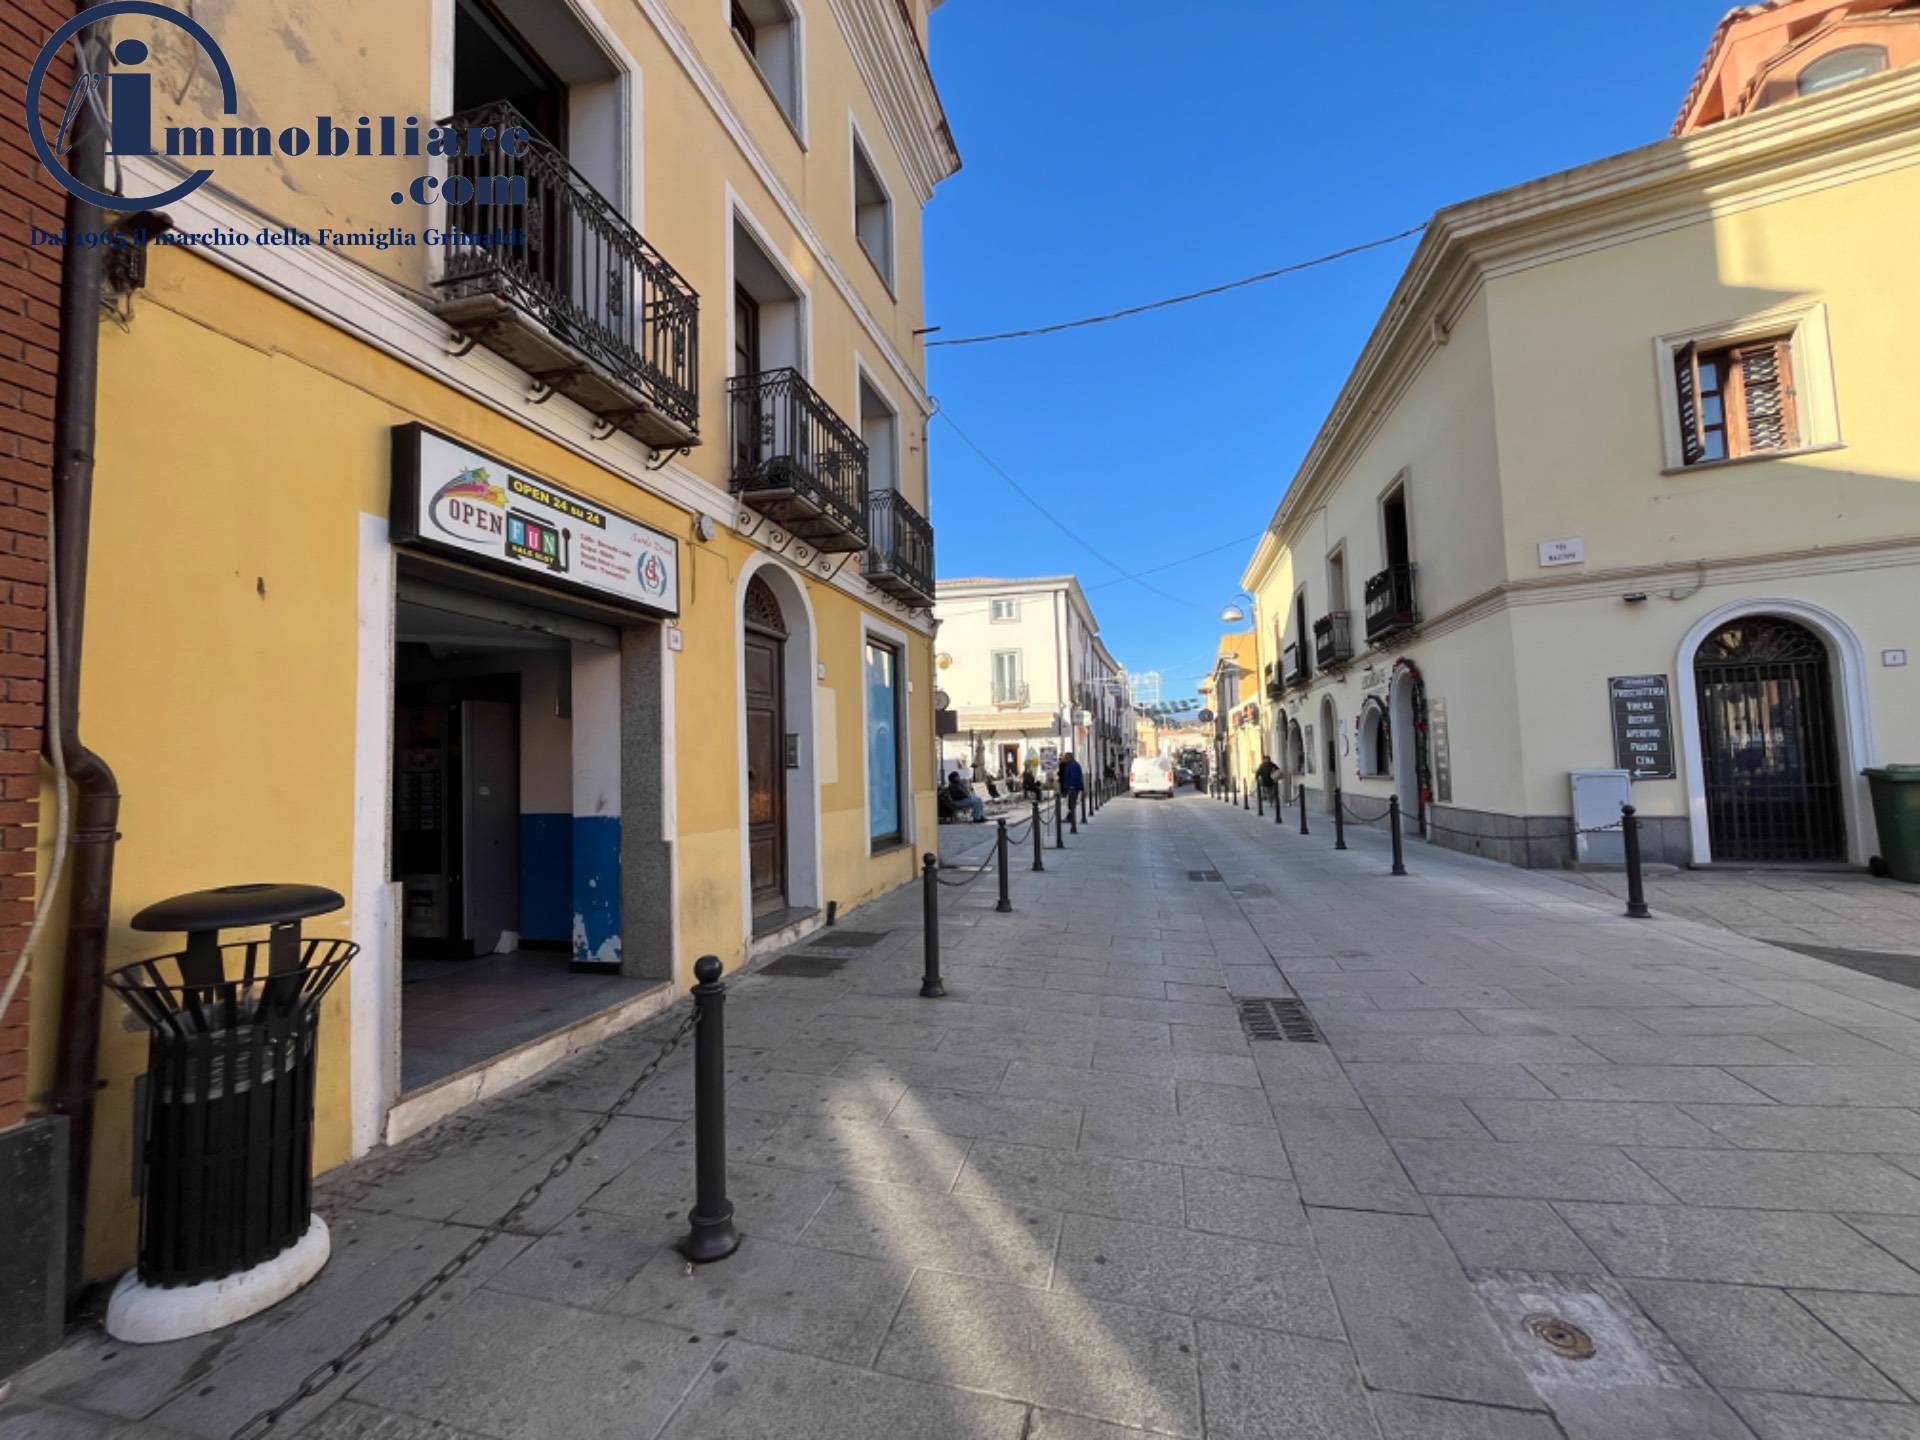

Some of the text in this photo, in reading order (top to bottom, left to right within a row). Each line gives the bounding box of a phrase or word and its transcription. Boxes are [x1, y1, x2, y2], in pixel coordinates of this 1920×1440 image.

[449, 499, 503, 536] OPEN
[514, 480, 600, 525] OPEN 24 su 24
[512, 518, 556, 556] FUN
